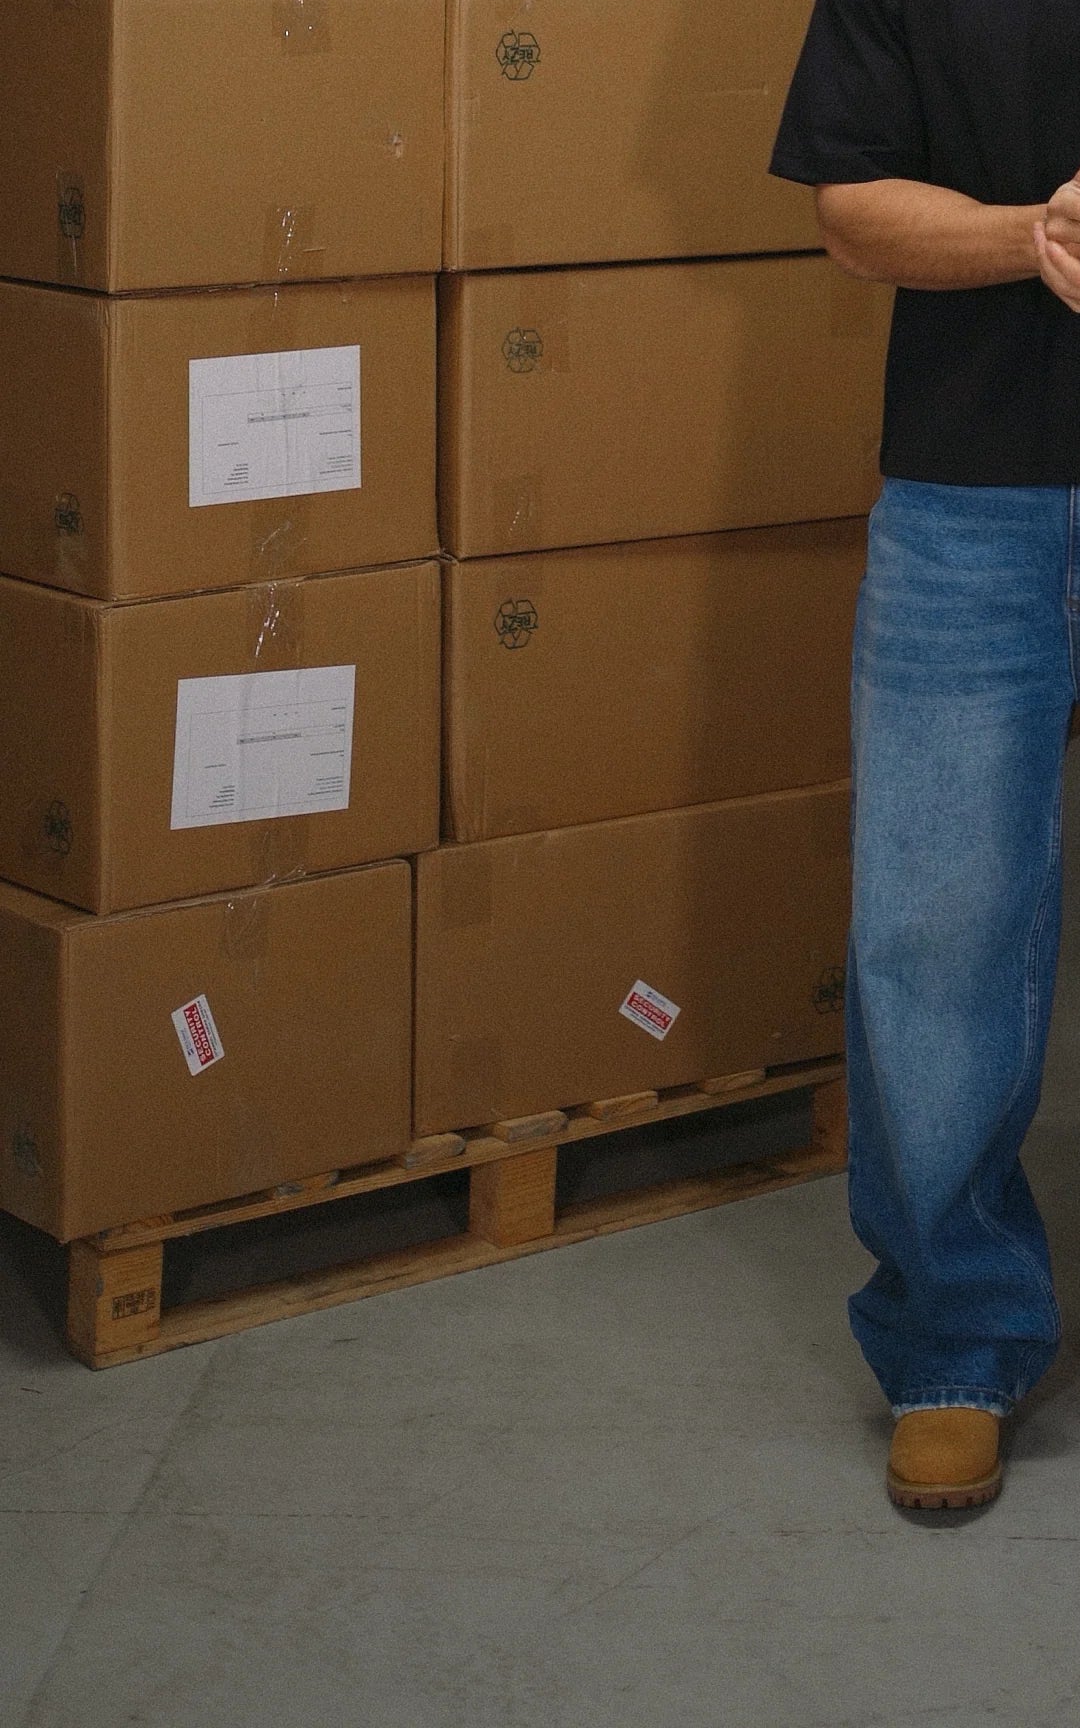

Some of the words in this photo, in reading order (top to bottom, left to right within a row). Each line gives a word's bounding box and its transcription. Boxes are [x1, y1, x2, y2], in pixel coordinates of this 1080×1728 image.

[503, 48, 534, 63] REZY
[500, 615, 531, 632] REZY
[631, 1001, 666, 1028] CONTROL
[185, 1010, 207, 1062] SECURITY
[191, 1006, 212, 1056] CONTROL
